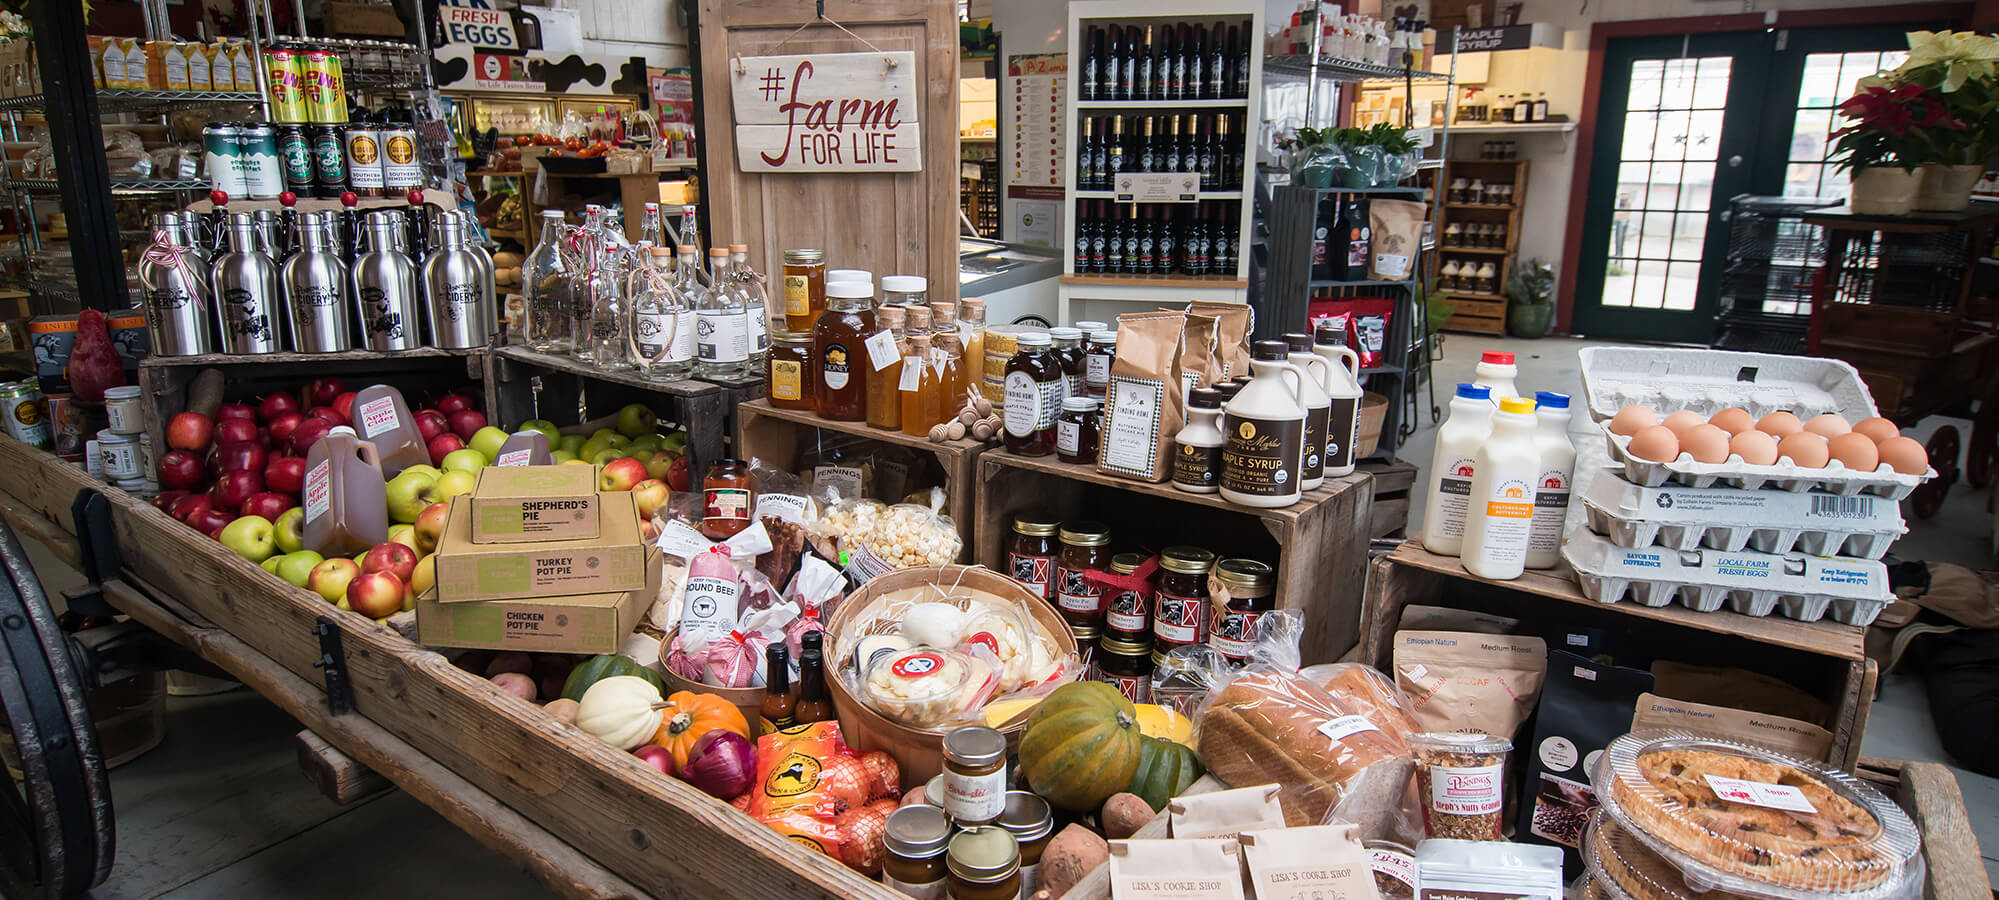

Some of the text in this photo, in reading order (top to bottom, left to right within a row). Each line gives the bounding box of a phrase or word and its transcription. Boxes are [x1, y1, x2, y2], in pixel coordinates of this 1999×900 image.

[452, 9, 499, 24] FRESH
[449, 22, 512, 46] EGGS
[1458, 29, 1505, 40] MAPLE
[1458, 39, 1502, 49] SYRUP
[801, 132, 899, 164] FOR LIFE
[446, 292, 474, 302] CIDERY
[824, 363, 849, 372] HONEY
[366, 410, 393, 423] Apple
[367, 415, 393, 428] Cider
[1247, 458, 1283, 470] SYRUP
[817, 468, 861, 479] PENNINGS
[522, 500, 588, 511] SHEPHERD'S
[759, 495, 804, 508] PENNINGS
[522, 512, 540, 521] PIE
[536, 557, 573, 567] TURKEY
[1623, 559, 1661, 568] DIFFERENCE
[1718, 558, 1769, 569] LOCAL FARM
[536, 567, 572, 576] POT PIE
[1718, 567, 1769, 578] FRESH EGGS
[1836, 569, 1868, 577] Refrigerated
[686, 583, 735, 596] OUND BEEF
[506, 612, 545, 622] CHICKEN
[506, 622, 540, 631] POT PIE
[1406, 638, 1458, 646] Ethiopian Natural
[1480, 643, 1532, 653] Medium Roast
[1650, 703, 1715, 719] Ethiopian Natural
[1749, 719, 1816, 737] Medium Roast
[1435, 800, 1460, 812] Steph's
[1461, 802, 1479, 812] Nutty
[1271, 868, 1352, 882] LISA'S COOKIE SHOP
[1131, 881, 1222, 891] LISA'S COOKIE SHOP
